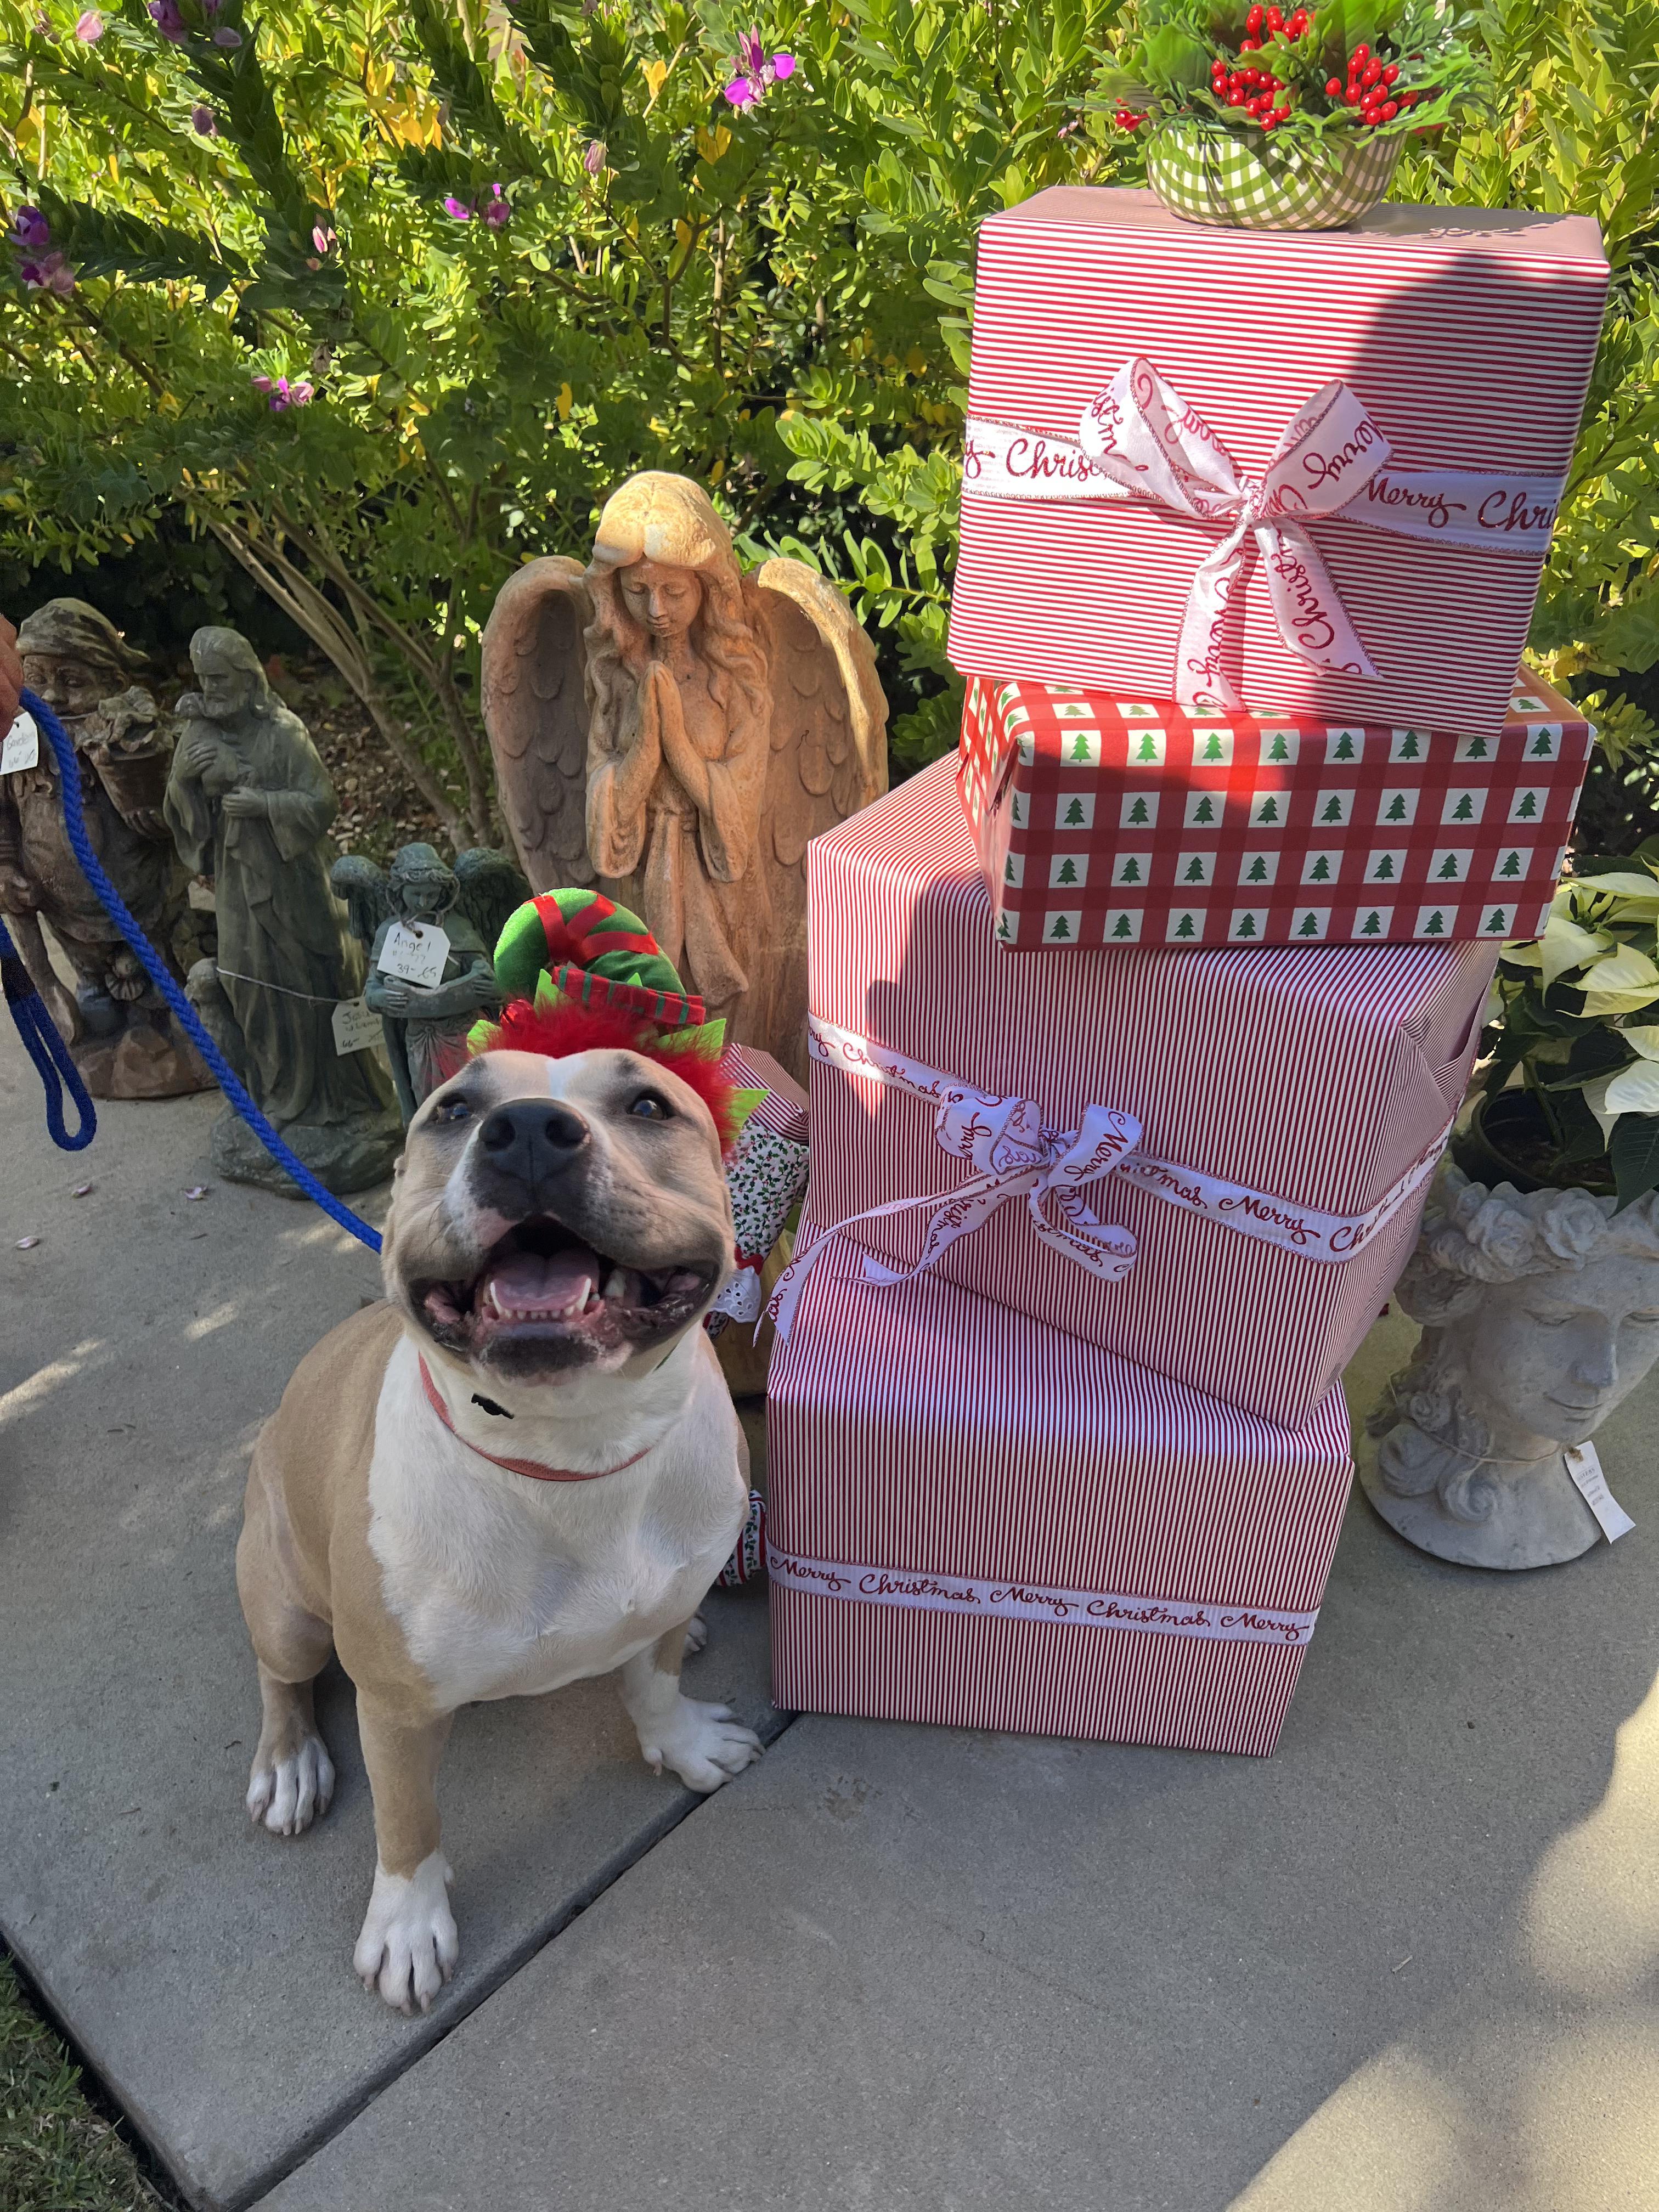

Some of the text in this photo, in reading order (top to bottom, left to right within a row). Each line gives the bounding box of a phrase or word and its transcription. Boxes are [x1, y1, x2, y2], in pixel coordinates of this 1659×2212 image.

[393, 932, 431, 953] Angel
[1064, 1110, 1129, 1181] Merry
[1218, 1195, 1321, 1245] Merry
[770, 1556, 1310, 1641] Merry Christmas Merry Christmas Merry
